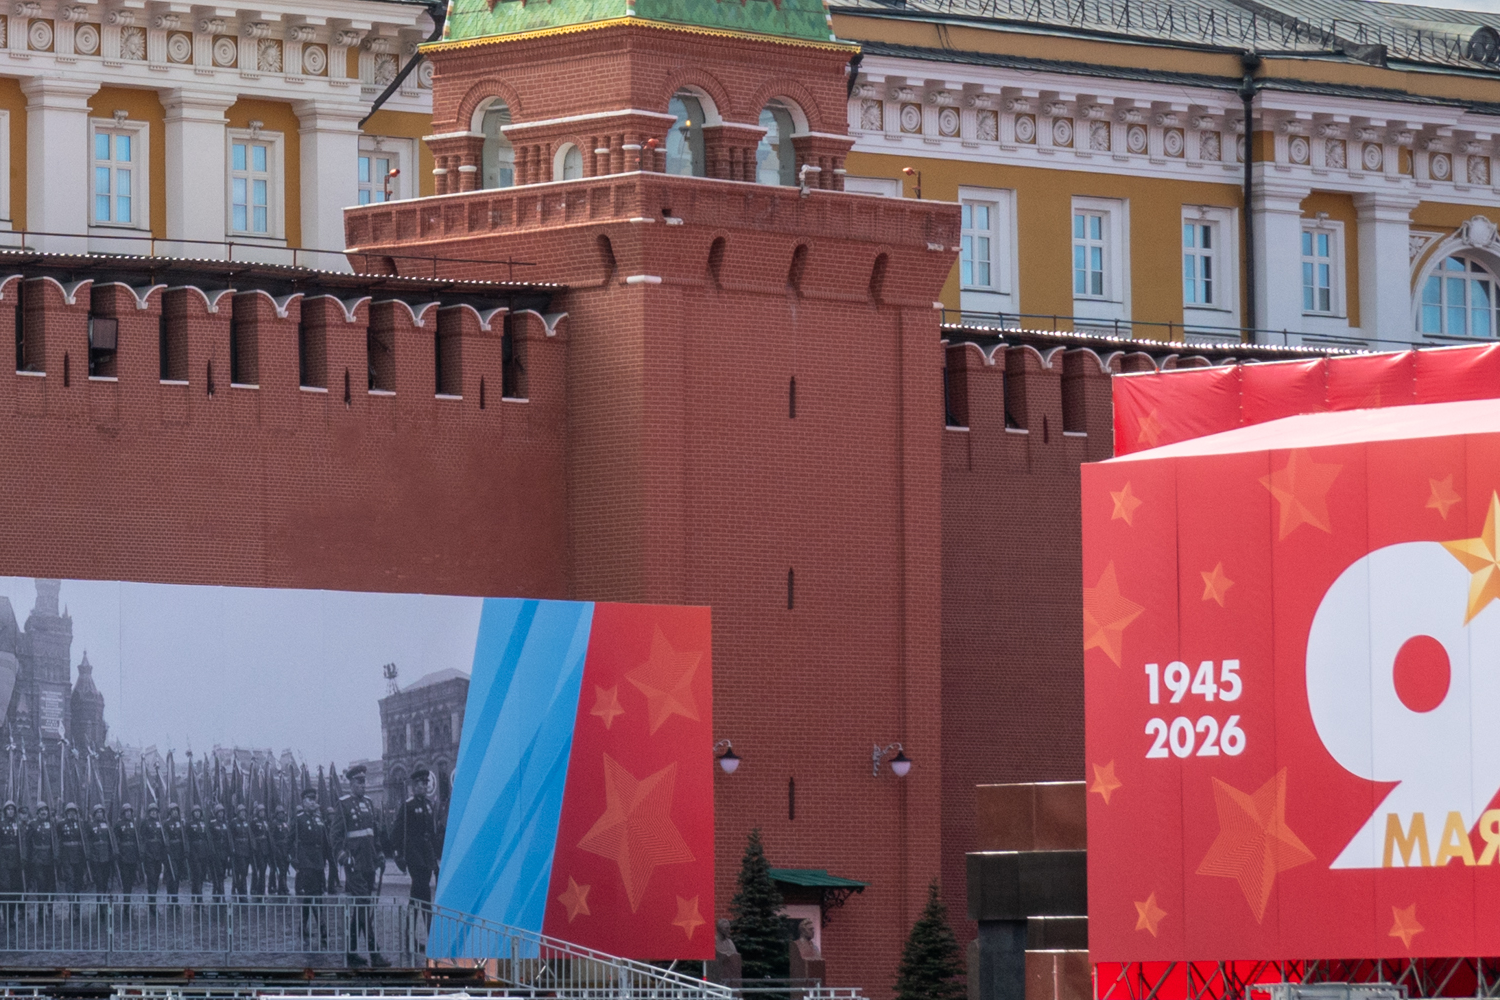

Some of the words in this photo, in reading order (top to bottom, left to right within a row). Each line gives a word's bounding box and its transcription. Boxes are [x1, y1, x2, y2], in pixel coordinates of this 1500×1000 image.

[1144, 659, 1242, 704] 1945
[1305, 541, 1500, 869] 9
[1144, 715, 1246, 758] 2026
